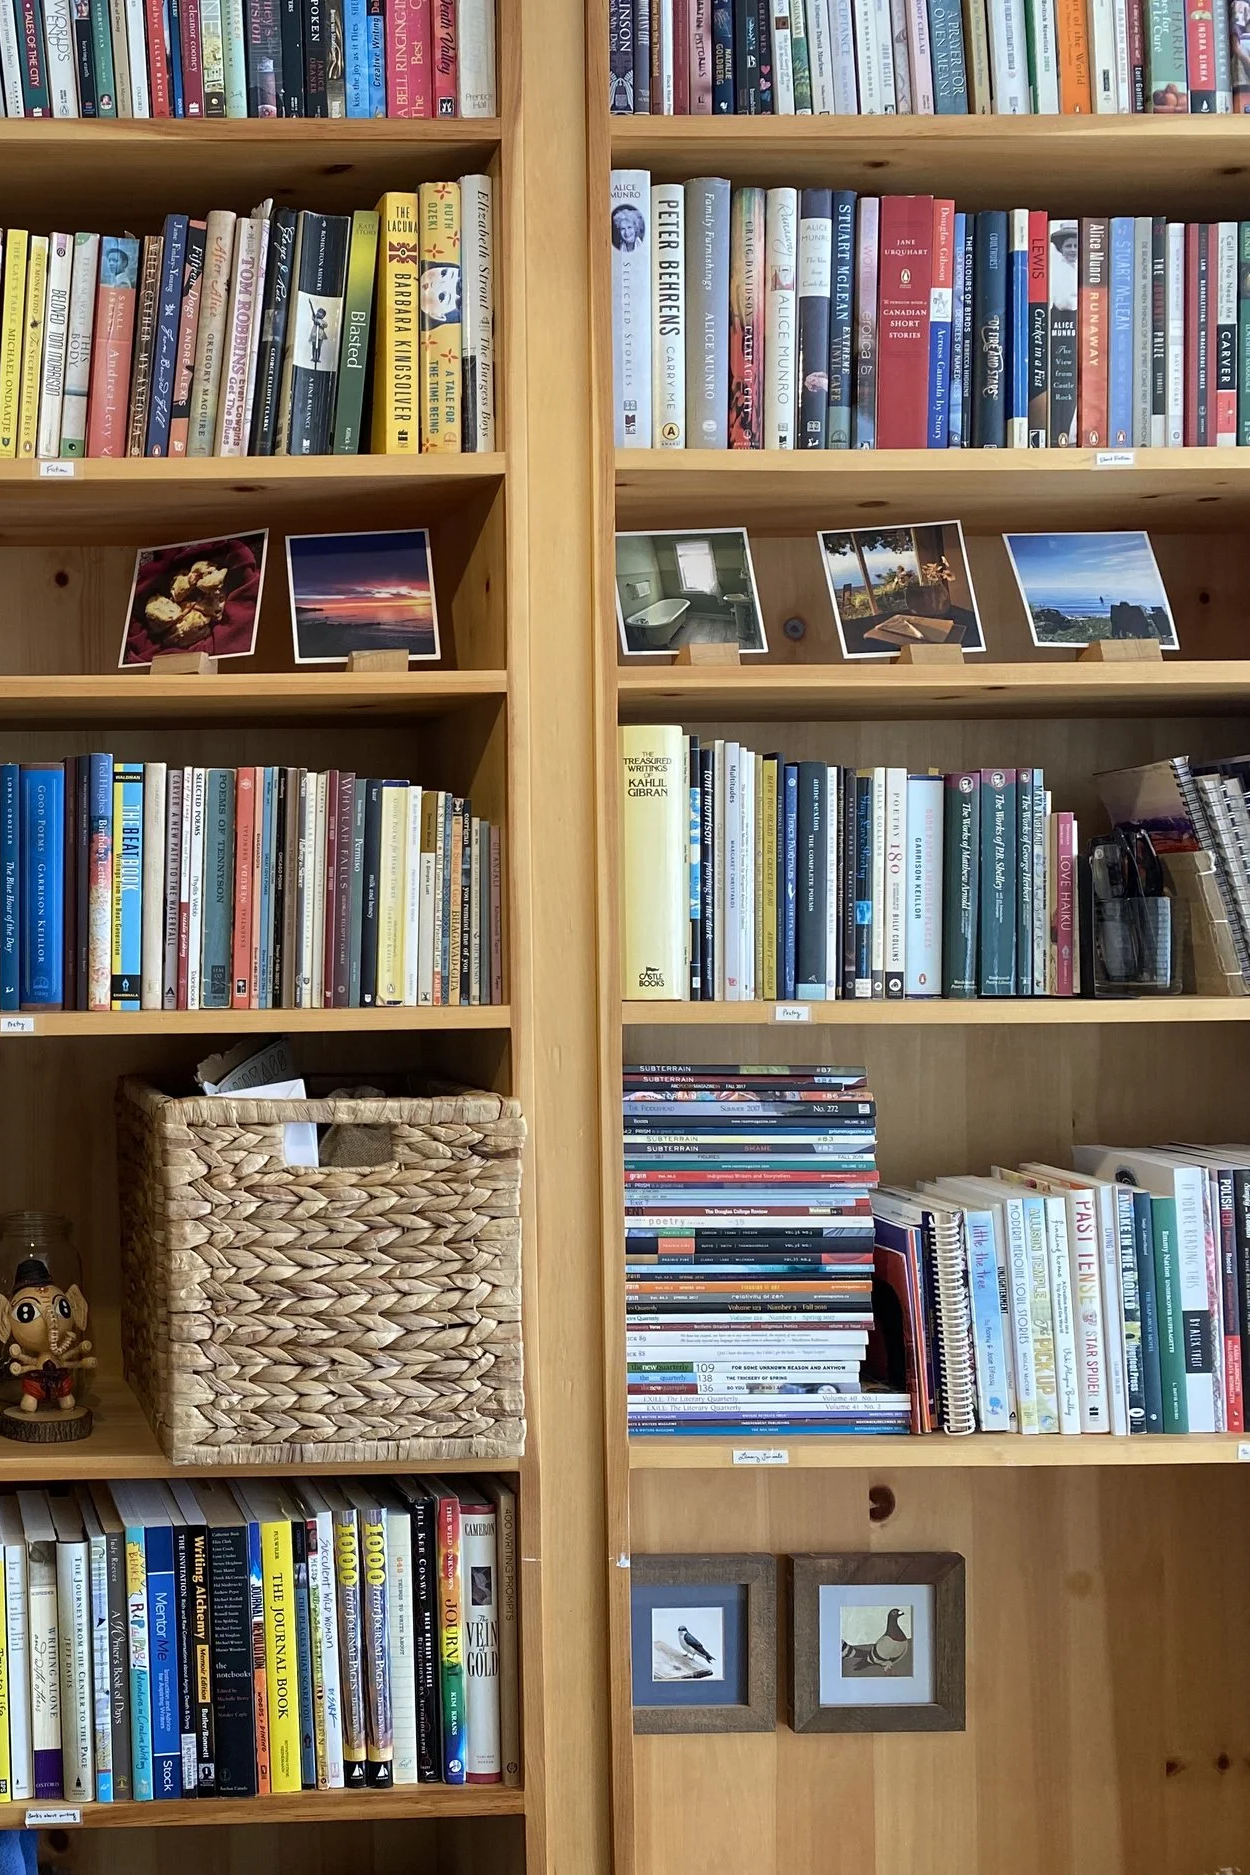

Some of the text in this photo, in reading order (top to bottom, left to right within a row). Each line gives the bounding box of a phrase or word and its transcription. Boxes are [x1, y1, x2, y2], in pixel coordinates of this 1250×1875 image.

[25, 11, 39, 86] TALES OF THE CITY
[372, 18, 381, 87] Creative Writing
[934, 8, 950, 97] OWEN MEANY
[948, 11, 965, 95] A PRAYER FOR
[388, 220, 418, 233] LACUNA
[396, 206, 410, 218] THE
[1032, 238, 1044, 279] LEWIS
[1090, 224, 1104, 283] Alice Munro
[658, 200, 680, 409] PETER BEHRENS CARRY ME
[1090, 292, 1099, 366] RUNAWAY
[346, 311, 366, 369] Blasted
[394, 273, 412, 421] BARBARA KINGSOLVER
[861, 311, 872, 374] erotica 07
[1221, 331, 1230, 382] CARVER
[429, 360, 439, 434] THE TIME BEING
[446, 370, 455, 423] A TALE FOR
[623, 757, 672, 765] TREASURED
[628, 779, 667, 787] KAHLIL
[628, 788, 668, 797] GIBRAN
[216, 774, 226, 904] POEMS OF TENNYSON
[1060, 855, 1071, 931] LOVE HAIKU
[696, 1363, 715, 1373] 109
[1086, 1330, 1099, 1398] STAR SPIDER
[464, 1523, 495, 1536] CAMERON
[192, 1536, 205, 1639] Writing Alchemy
[272, 1572, 289, 1719] THE JOURNAL BOOK
[163, 1760, 172, 1792] Stock
